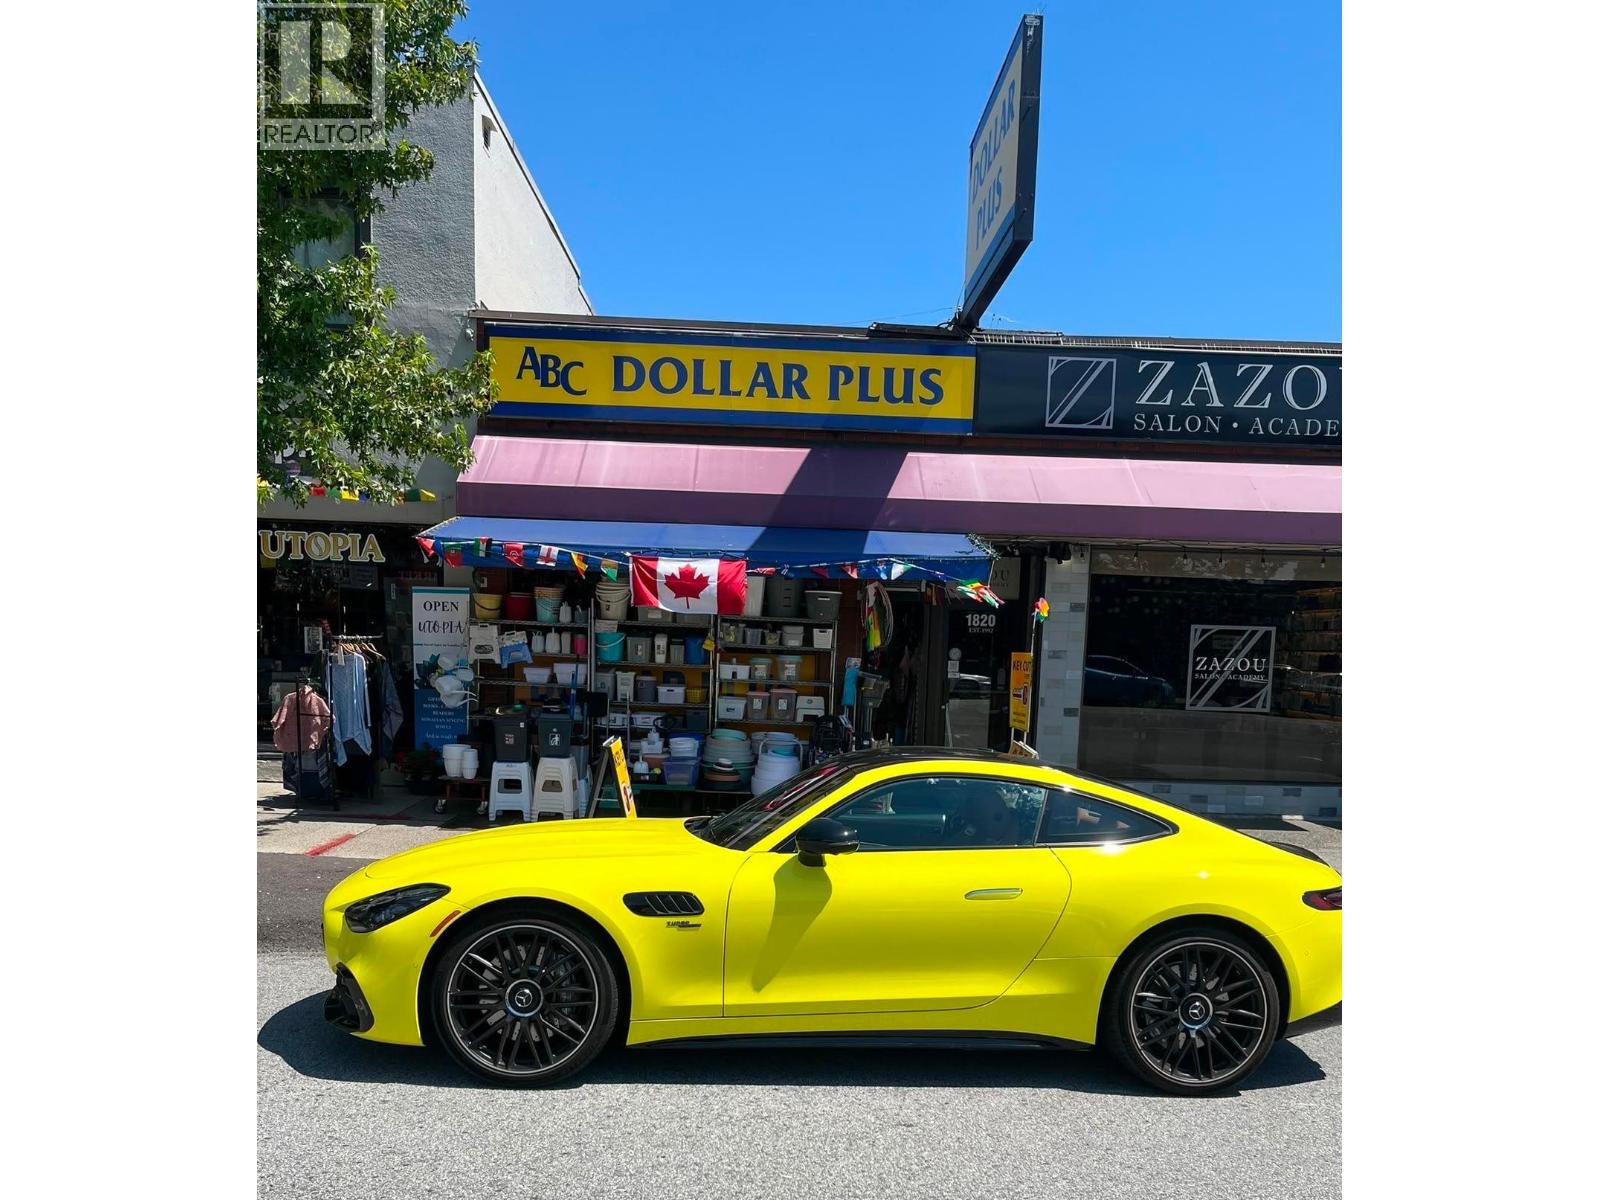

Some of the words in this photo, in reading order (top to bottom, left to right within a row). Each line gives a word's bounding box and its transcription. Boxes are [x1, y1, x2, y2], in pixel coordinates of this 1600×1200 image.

[972, 79, 1015, 203] DOLLAR
[976, 165, 1002, 251] PLUS
[516, 346, 587, 396] ABC
[612, 355, 809, 400] DOLLAR
[828, 364, 945, 406] PLUS
[1136, 360, 1342, 410] ZAZO
[1133, 413, 1222, 433] SALON
[258, 530, 385, 563] UTOPIA
[423, 600, 460, 613] OPEN
[965, 613, 996, 628] 1820
[1195, 657, 1266, 672] ZAZOU
